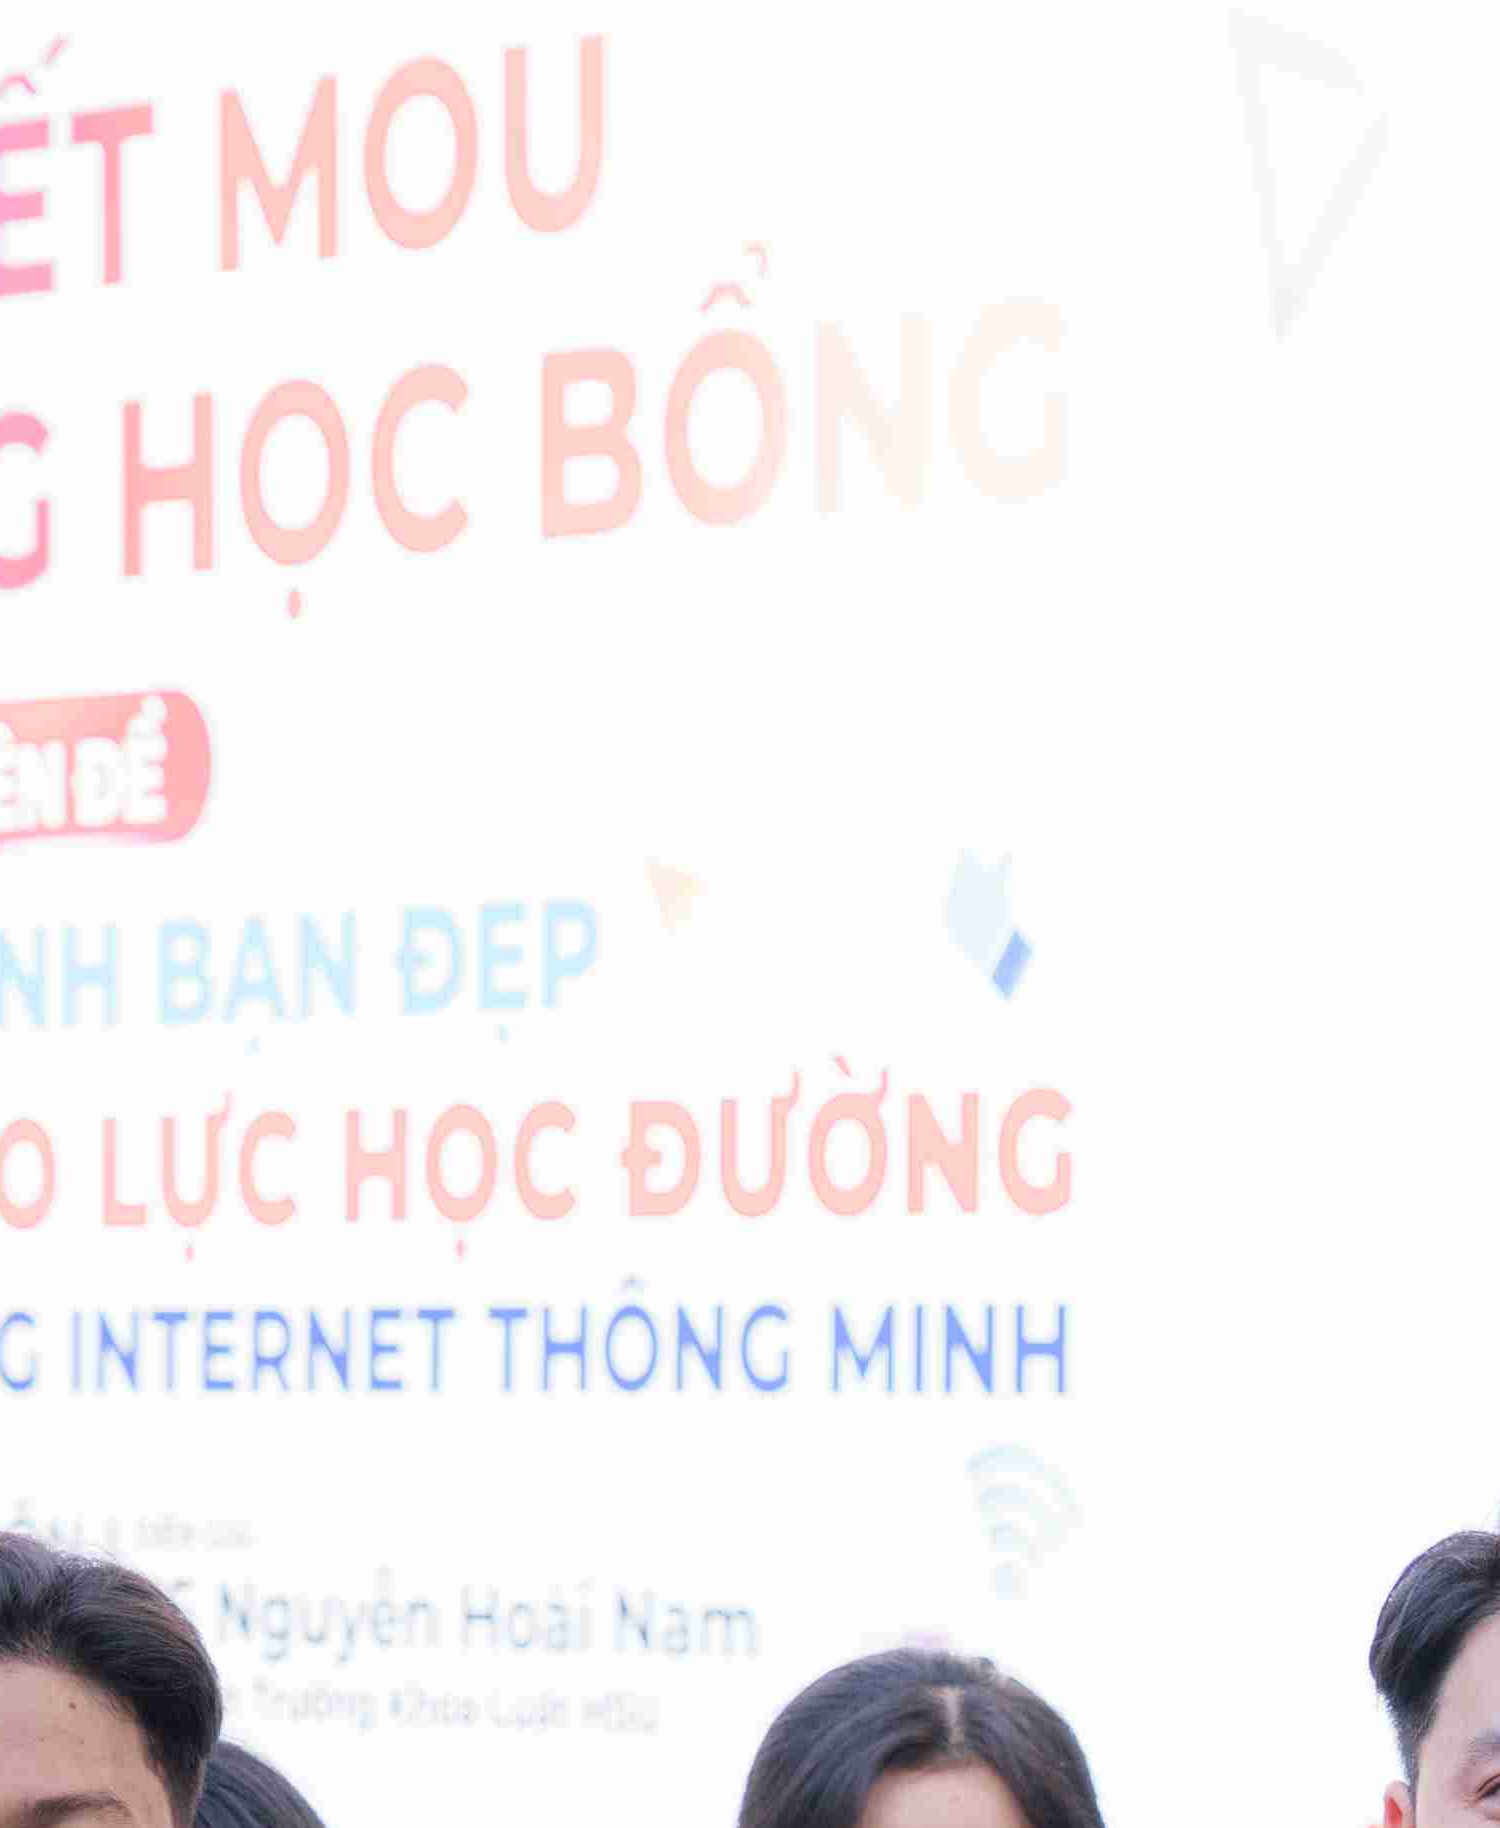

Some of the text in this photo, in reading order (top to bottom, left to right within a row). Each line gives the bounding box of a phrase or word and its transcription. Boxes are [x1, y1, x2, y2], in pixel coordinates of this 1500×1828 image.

[217, 34, 605, 271] MOU
[122, 362, 470, 618] HỌC
[538, 240, 1069, 538] BỔNG
[156, 910, 358, 1054] BẠN
[394, 898, 598, 1042] ĐẸP
[102, 1091, 298, 1261] LỰC
[344, 1099, 577, 1258] HỌC
[619, 1055, 1073, 1217] ĐƯỜNG
[71, 1308, 456, 1393] INTERNET
[488, 1275, 790, 1394] THÔNG
[831, 1302, 1068, 1395] MINH
[610, 1586, 760, 1661] Nam
